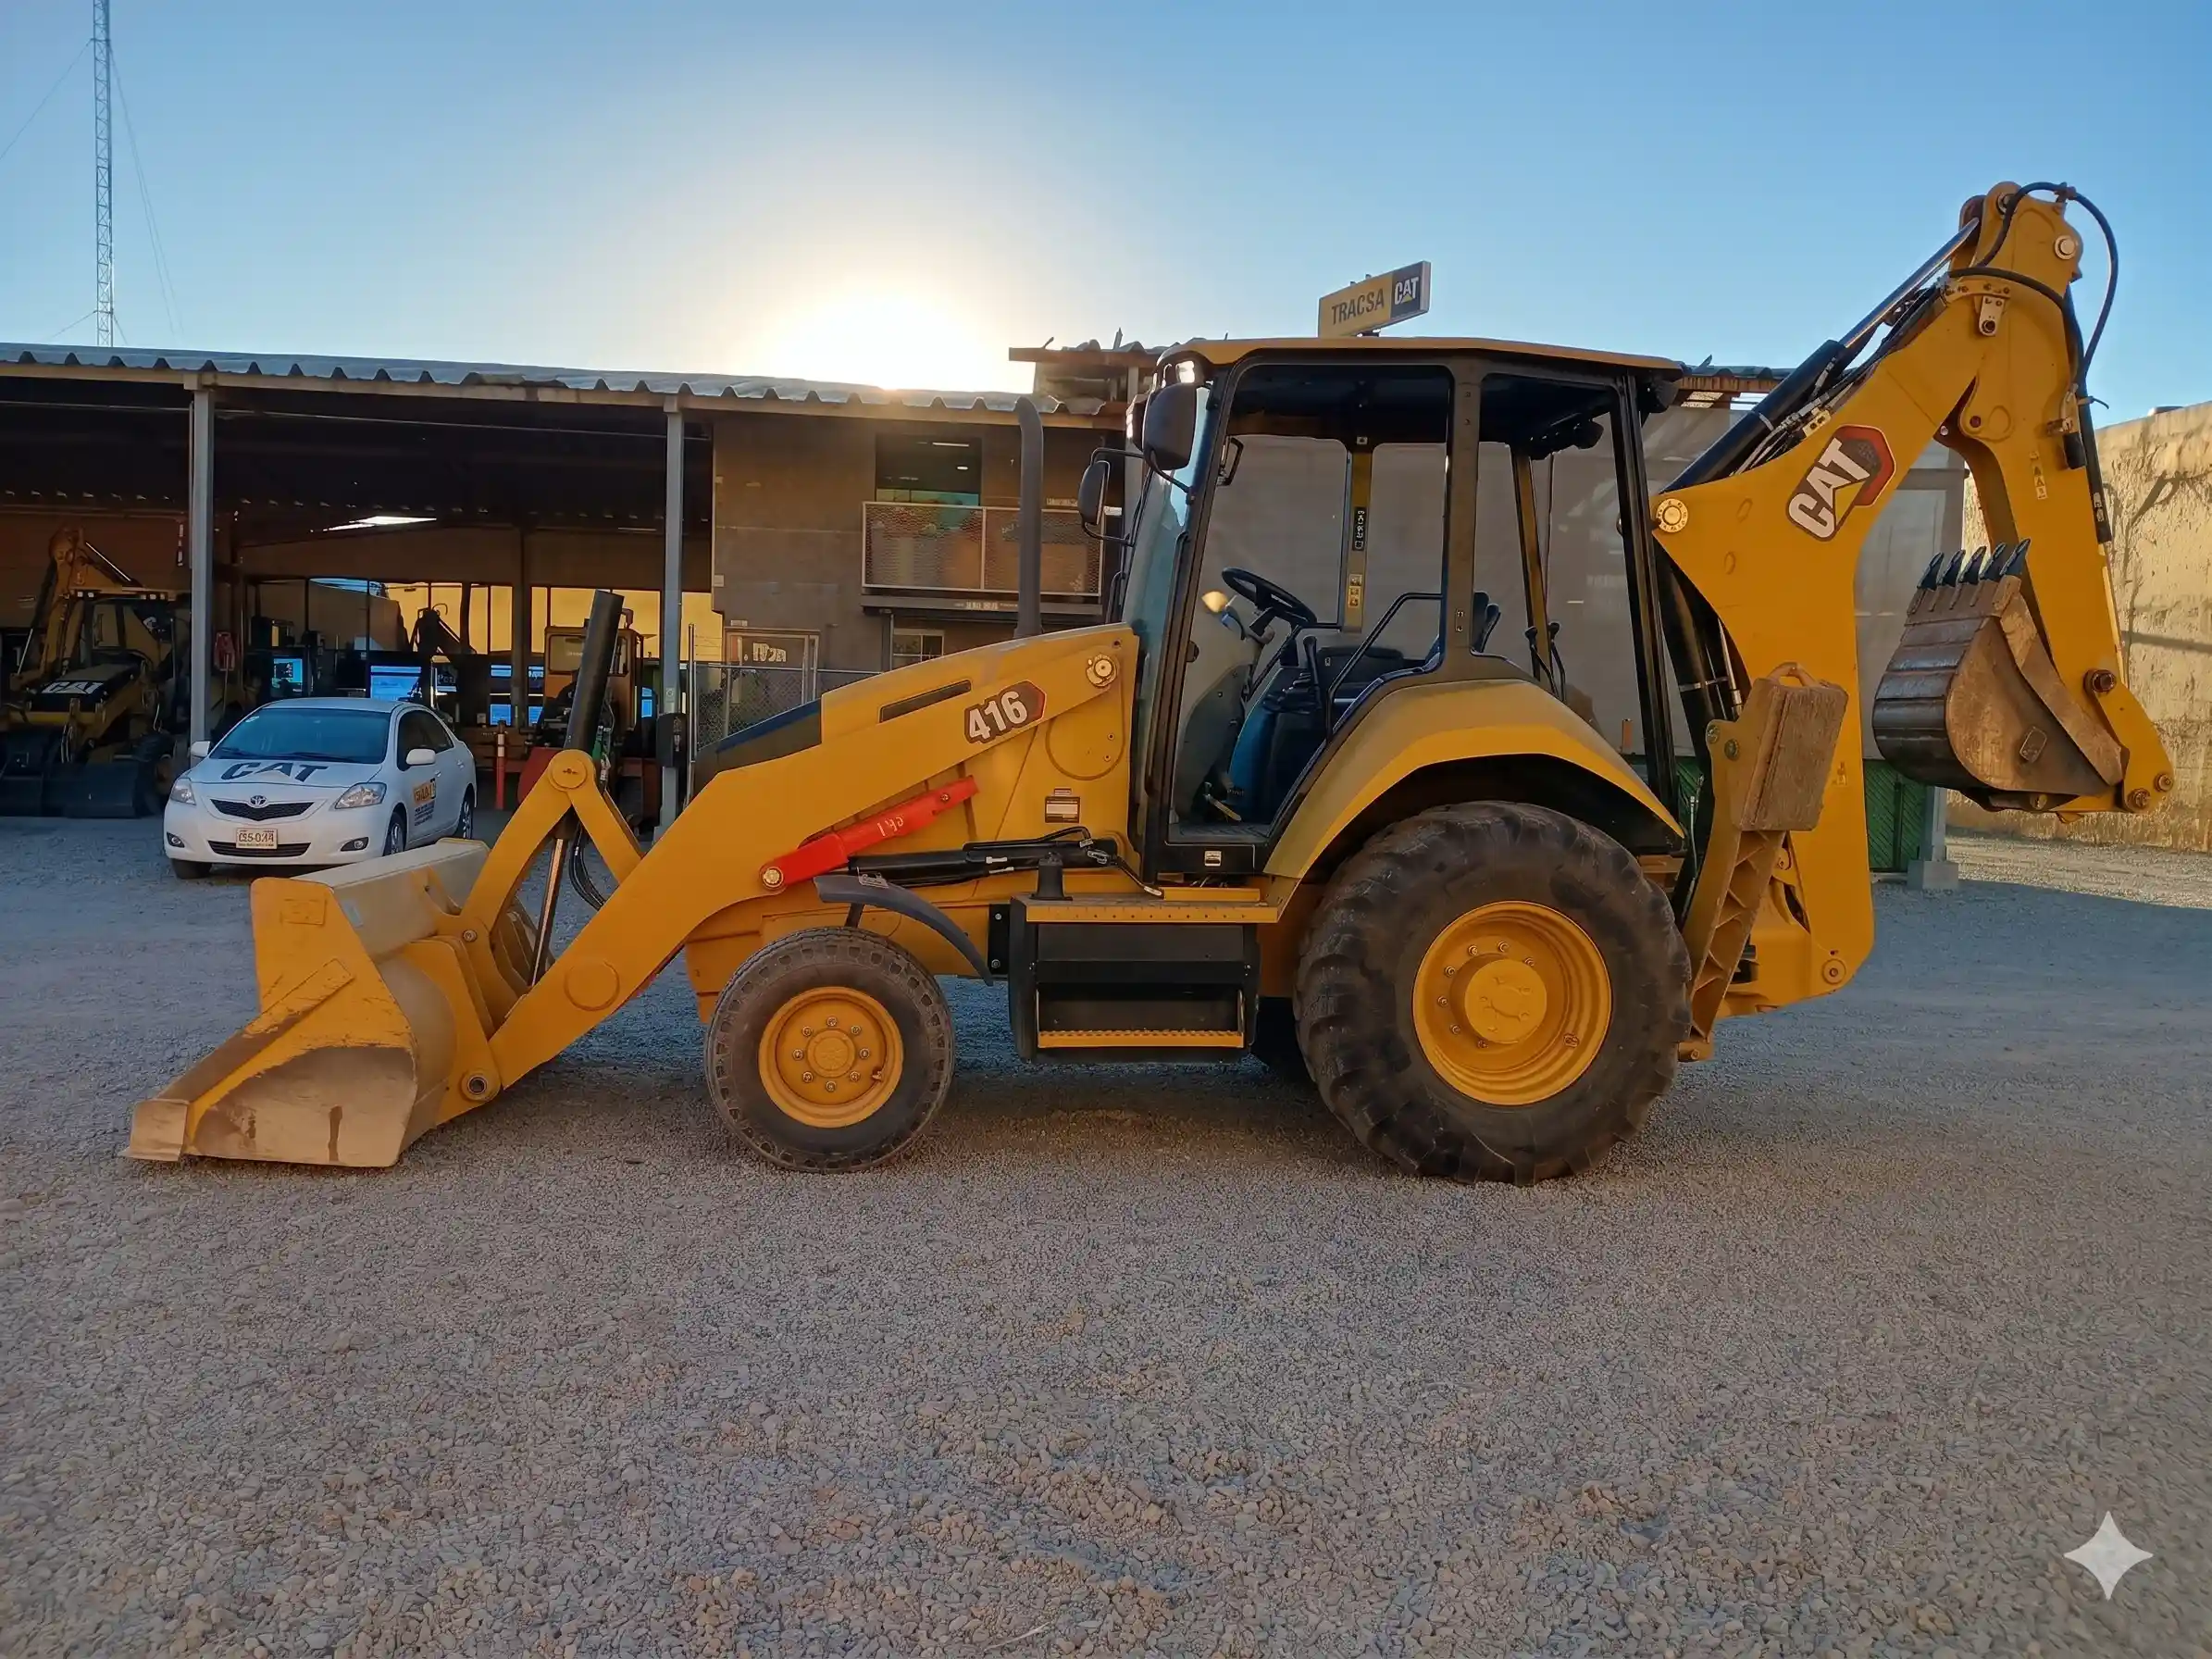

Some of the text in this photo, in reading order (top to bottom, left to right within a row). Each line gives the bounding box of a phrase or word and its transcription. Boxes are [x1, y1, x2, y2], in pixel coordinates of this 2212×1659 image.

[1331, 276, 1420, 326] TRACSA CAT
[1788, 437, 1870, 538] CAT
[41, 680, 105, 695] CAT
[969, 691, 1028, 740] 416
[220, 762, 329, 783] CAT
